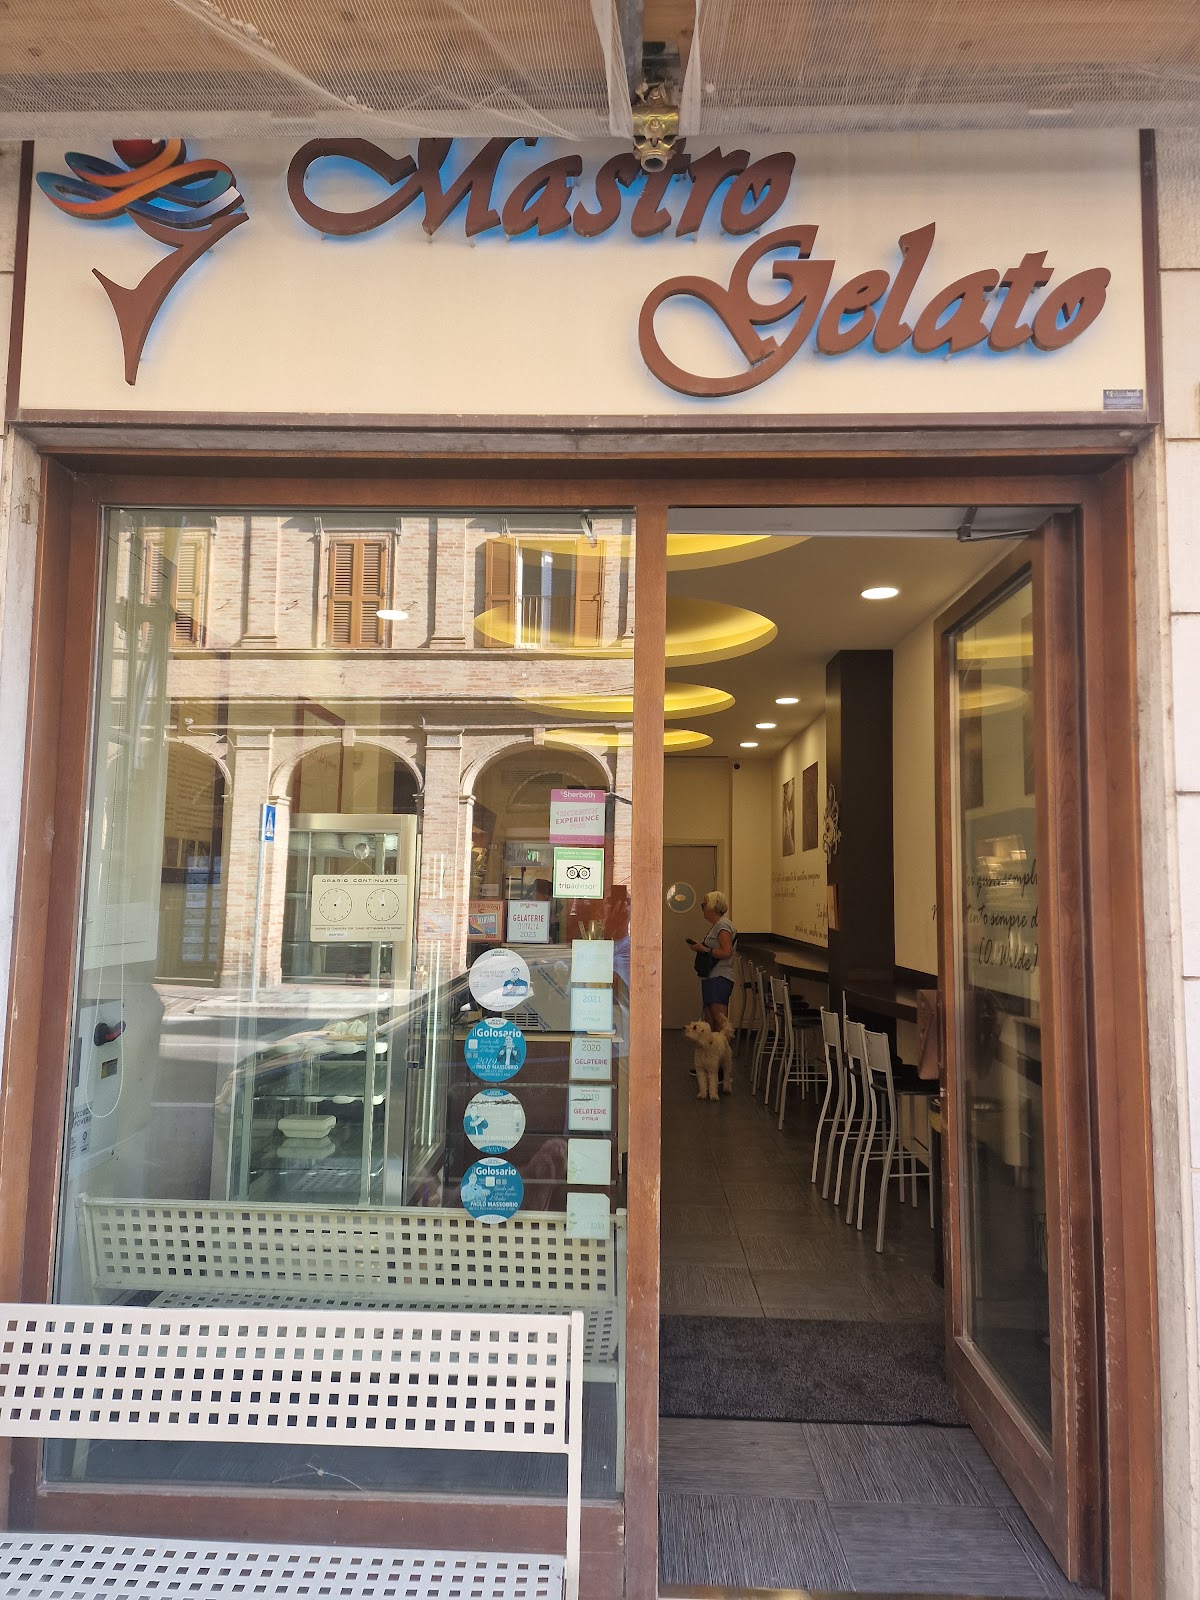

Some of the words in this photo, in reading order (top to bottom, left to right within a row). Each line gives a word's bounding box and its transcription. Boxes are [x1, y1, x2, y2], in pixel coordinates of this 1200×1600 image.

[286, 137, 795, 238] Mastro
[638, 221, 1112, 399] Gelato
[555, 814, 600, 825] EXPERIENCE
[558, 882, 596, 890] tripadvisor
[512, 914, 545, 923] GELATERIE
[517, 923, 540, 931] D'ITALIA
[990, 914, 1028, 938] sempre
[582, 994, 602, 1003] 2021
[581, 1043, 602, 1052] 2020
[477, 1057, 498, 1065] 2019
[574, 1058, 608, 1066] GELATERIE
[580, 1093, 600, 1102] 2019
